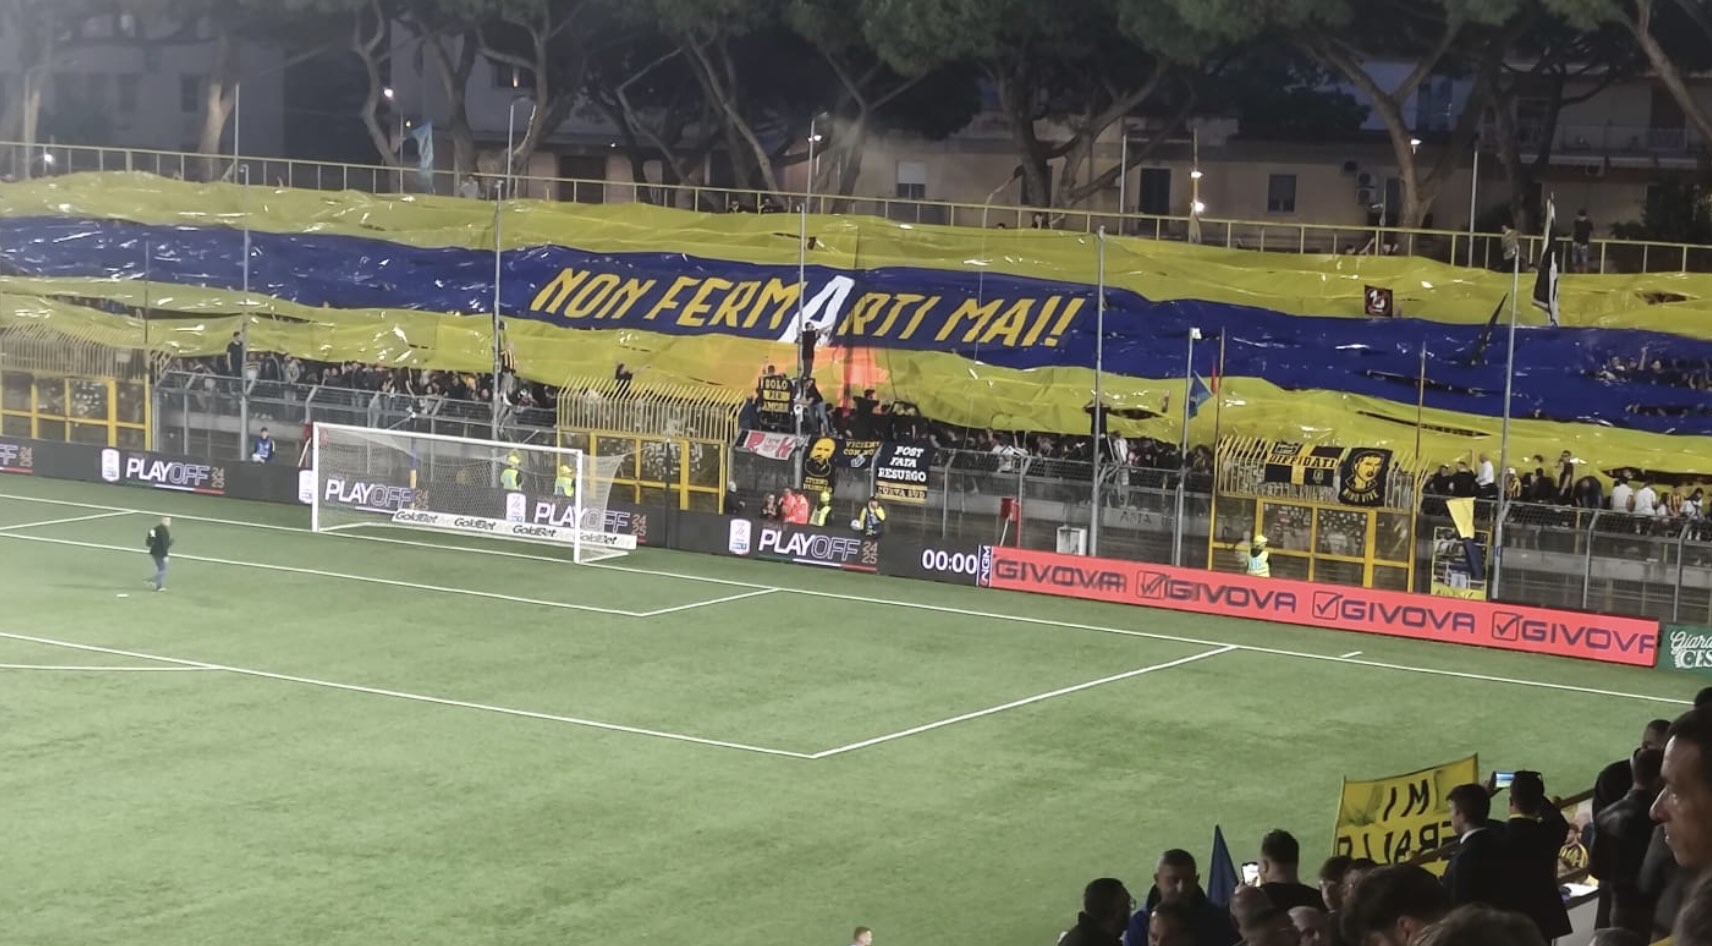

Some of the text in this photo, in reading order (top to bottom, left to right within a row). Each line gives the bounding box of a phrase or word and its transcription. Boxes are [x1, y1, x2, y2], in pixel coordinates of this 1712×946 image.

[530, 268, 1086, 346] NON FERMARTI MAI!
[894, 446, 924, 458] POST
[1268, 455, 1336, 468] DIFFIDATI
[126, 458, 210, 486] PLAYOFF
[889, 457, 917, 468] FATA
[878, 467, 926, 482] RESURGO
[325, 479, 412, 511] PLAYOFF
[454, 517, 497, 531] GoldBet
[513, 525, 556, 537] GoldBet
[758, 529, 860, 560] PLAYOFF
[863, 541, 878, 552] 24
[862, 552, 877, 564] 25
[922, 549, 977, 575] 00:00
[995, 558, 1127, 592] GIVOVA
[1164, 579, 1296, 613] GIVOVA
[1341, 599, 1475, 634] GIVOVA
